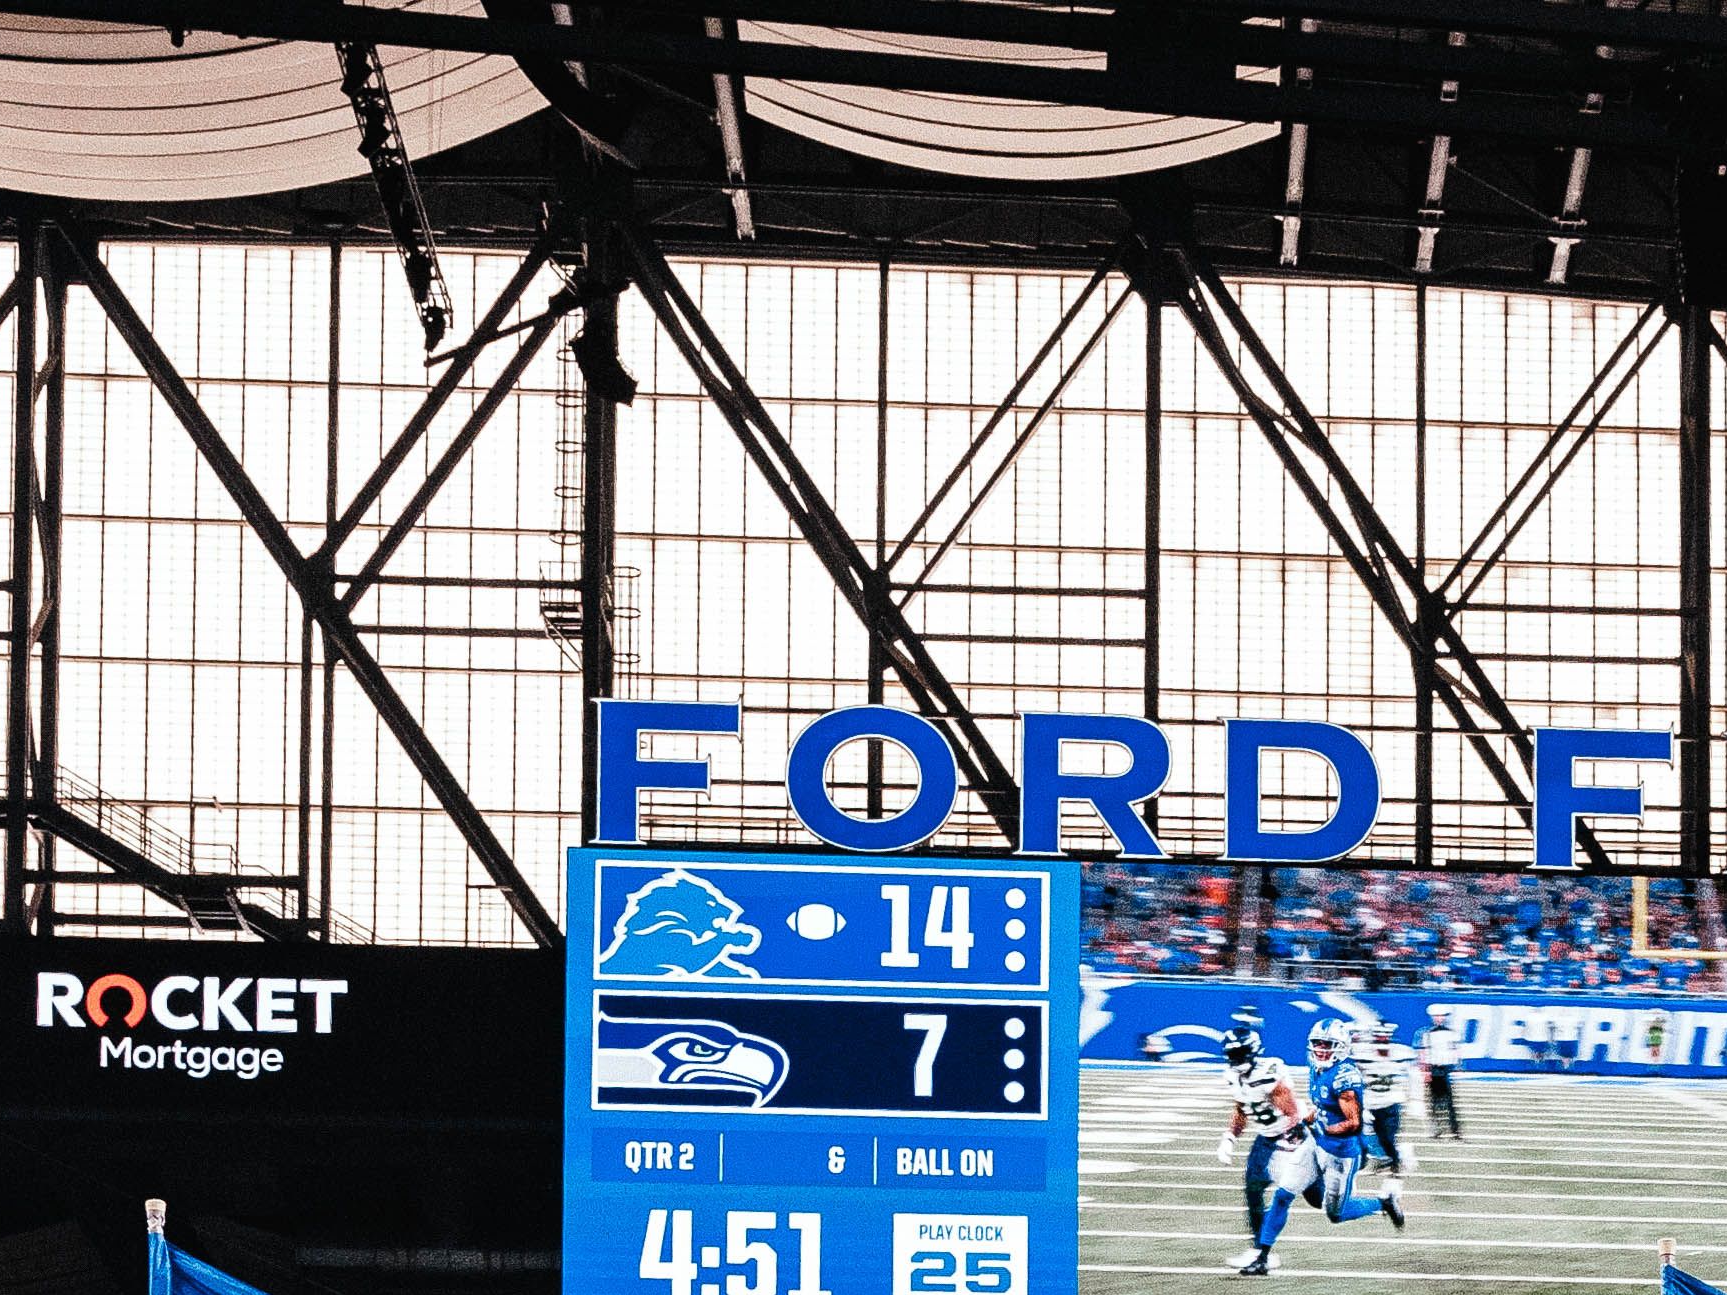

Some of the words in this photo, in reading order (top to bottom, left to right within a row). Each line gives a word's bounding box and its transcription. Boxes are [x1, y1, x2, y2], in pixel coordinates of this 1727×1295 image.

[594, 696, 1383, 864] FORD
[880, 884, 974, 969] 14
[36, 971, 348, 1034] ROCKET
[100, 1036, 284, 1080] Mortgage
[903, 1012, 948, 1097] 7
[625, 1141, 673, 1172] QTR
[678, 1143, 695, 1170] 2
[828, 1146, 846, 1174] &
[896, 1147, 954, 1176] BALL
[960, 1149, 994, 1177] ON
[919, 1224, 954, 1241] PLAY
[958, 1225, 1003, 1241] CLOCK
[910, 1251, 1012, 1294] 25
